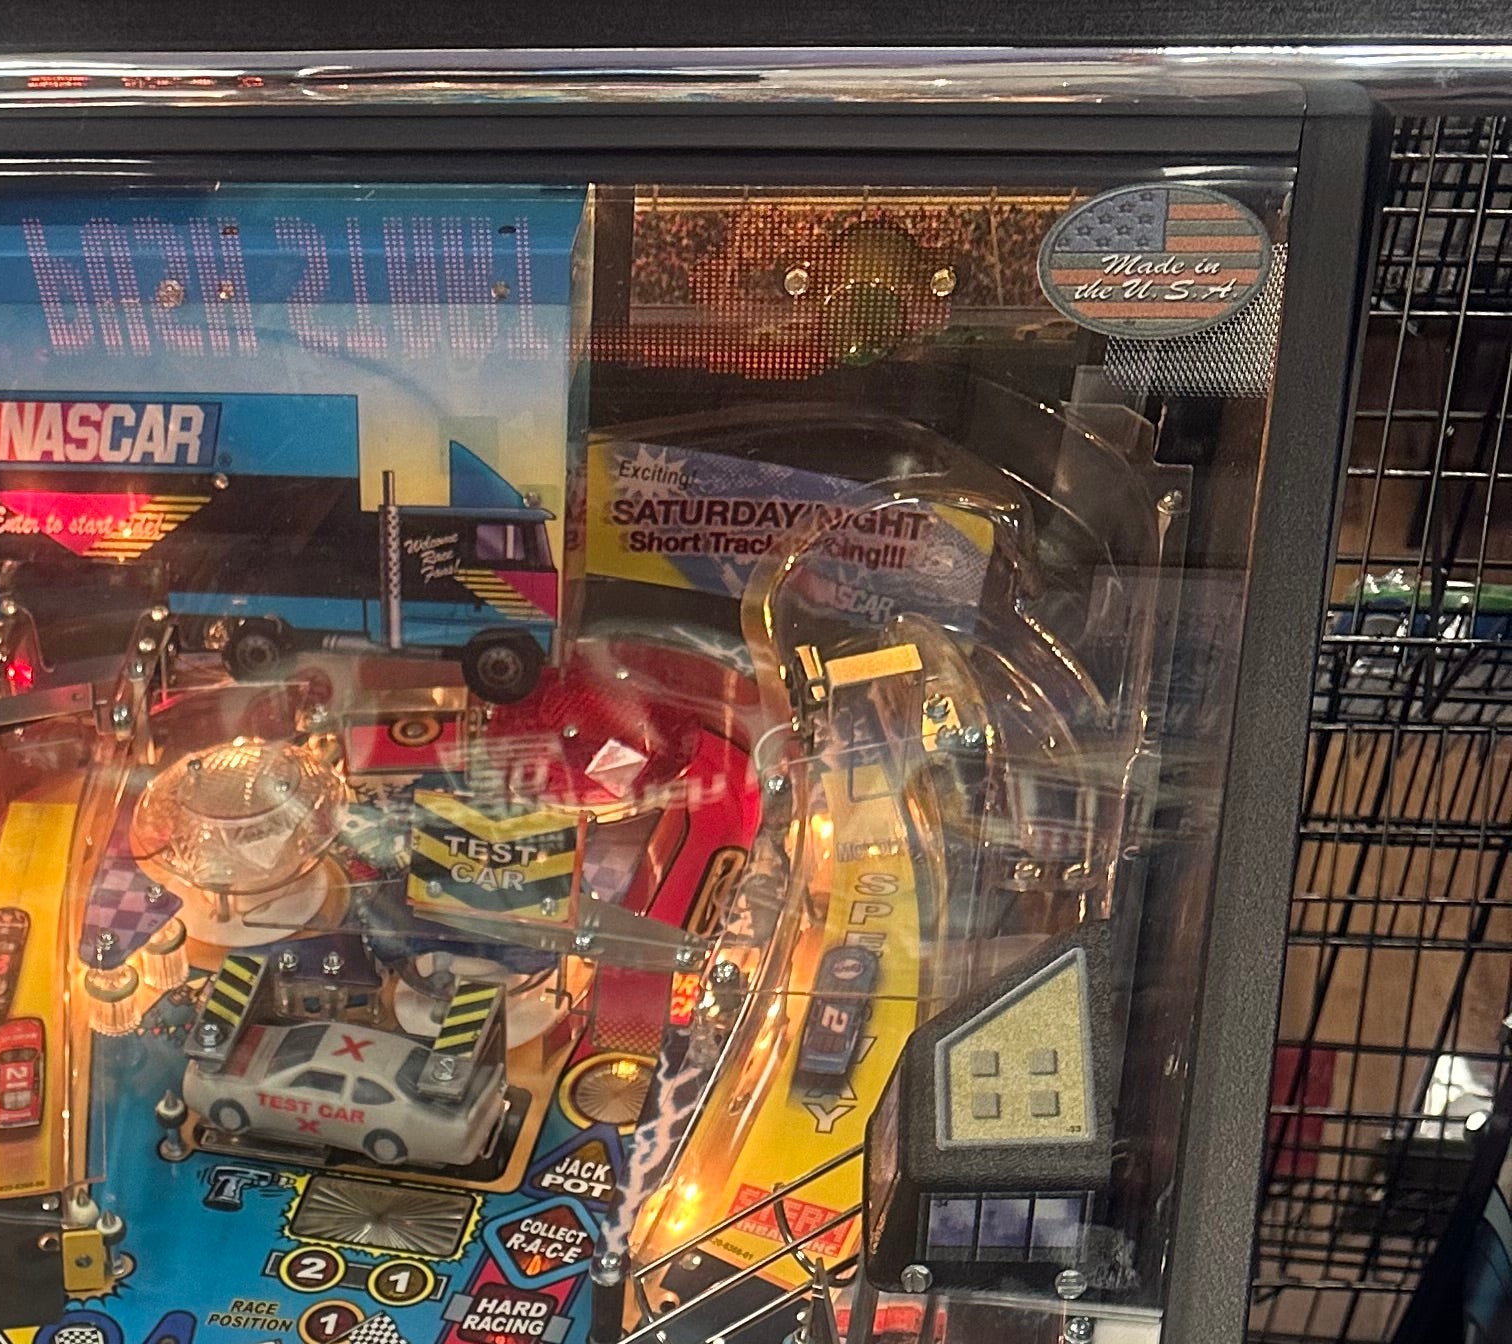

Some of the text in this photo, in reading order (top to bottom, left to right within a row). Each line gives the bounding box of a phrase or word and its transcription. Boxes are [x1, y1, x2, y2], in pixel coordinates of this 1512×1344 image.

[1101, 254, 1221, 275] Made in
[1074, 278, 1113, 300] the
[618, 460, 699, 489] Exciting!
[46, 513, 63, 534] to
[67, 511, 114, 536] start
[611, 499, 803, 528] SATURDAY
[443, 834, 539, 868] TEST
[450, 862, 526, 892] CAR
[554, 1156, 612, 1183] JACK
[540, 1176, 617, 1198] POT
[476, 1297, 549, 1320] HARD
[207, 1312, 294, 1333] POSITION
[462, 1315, 545, 1337] RACING
